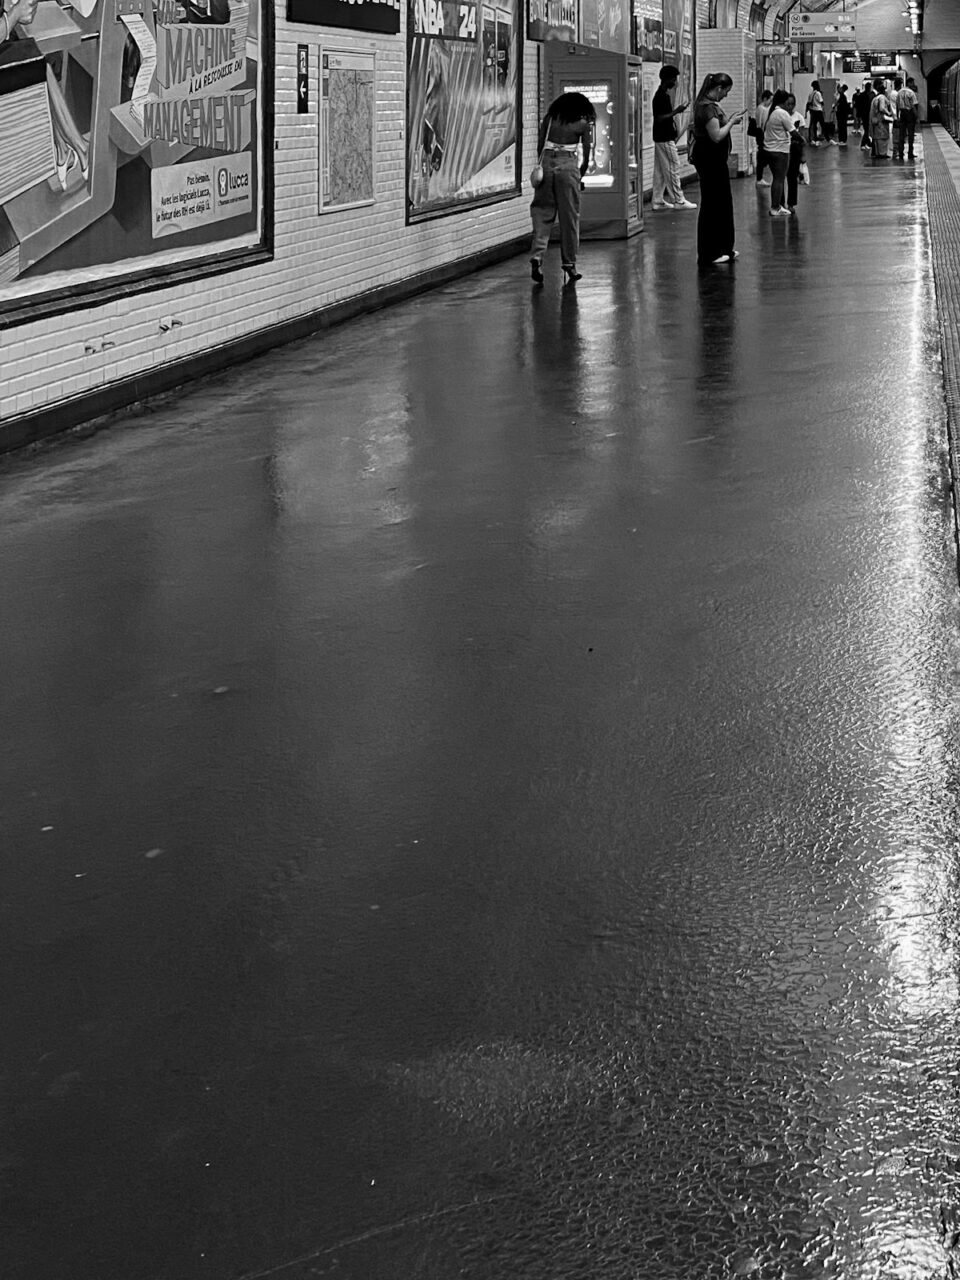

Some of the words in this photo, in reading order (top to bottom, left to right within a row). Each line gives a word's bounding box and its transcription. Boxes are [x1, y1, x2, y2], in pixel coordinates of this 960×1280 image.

[157, 0, 181, 25] UNE
[459, 4, 477, 39] 24
[165, 28, 236, 90] MACHINE
[194, 76, 202, 91] LA
[203, 62, 233, 89] RESCOUSSE
[143, 95, 246, 152] MANAGEMENT
